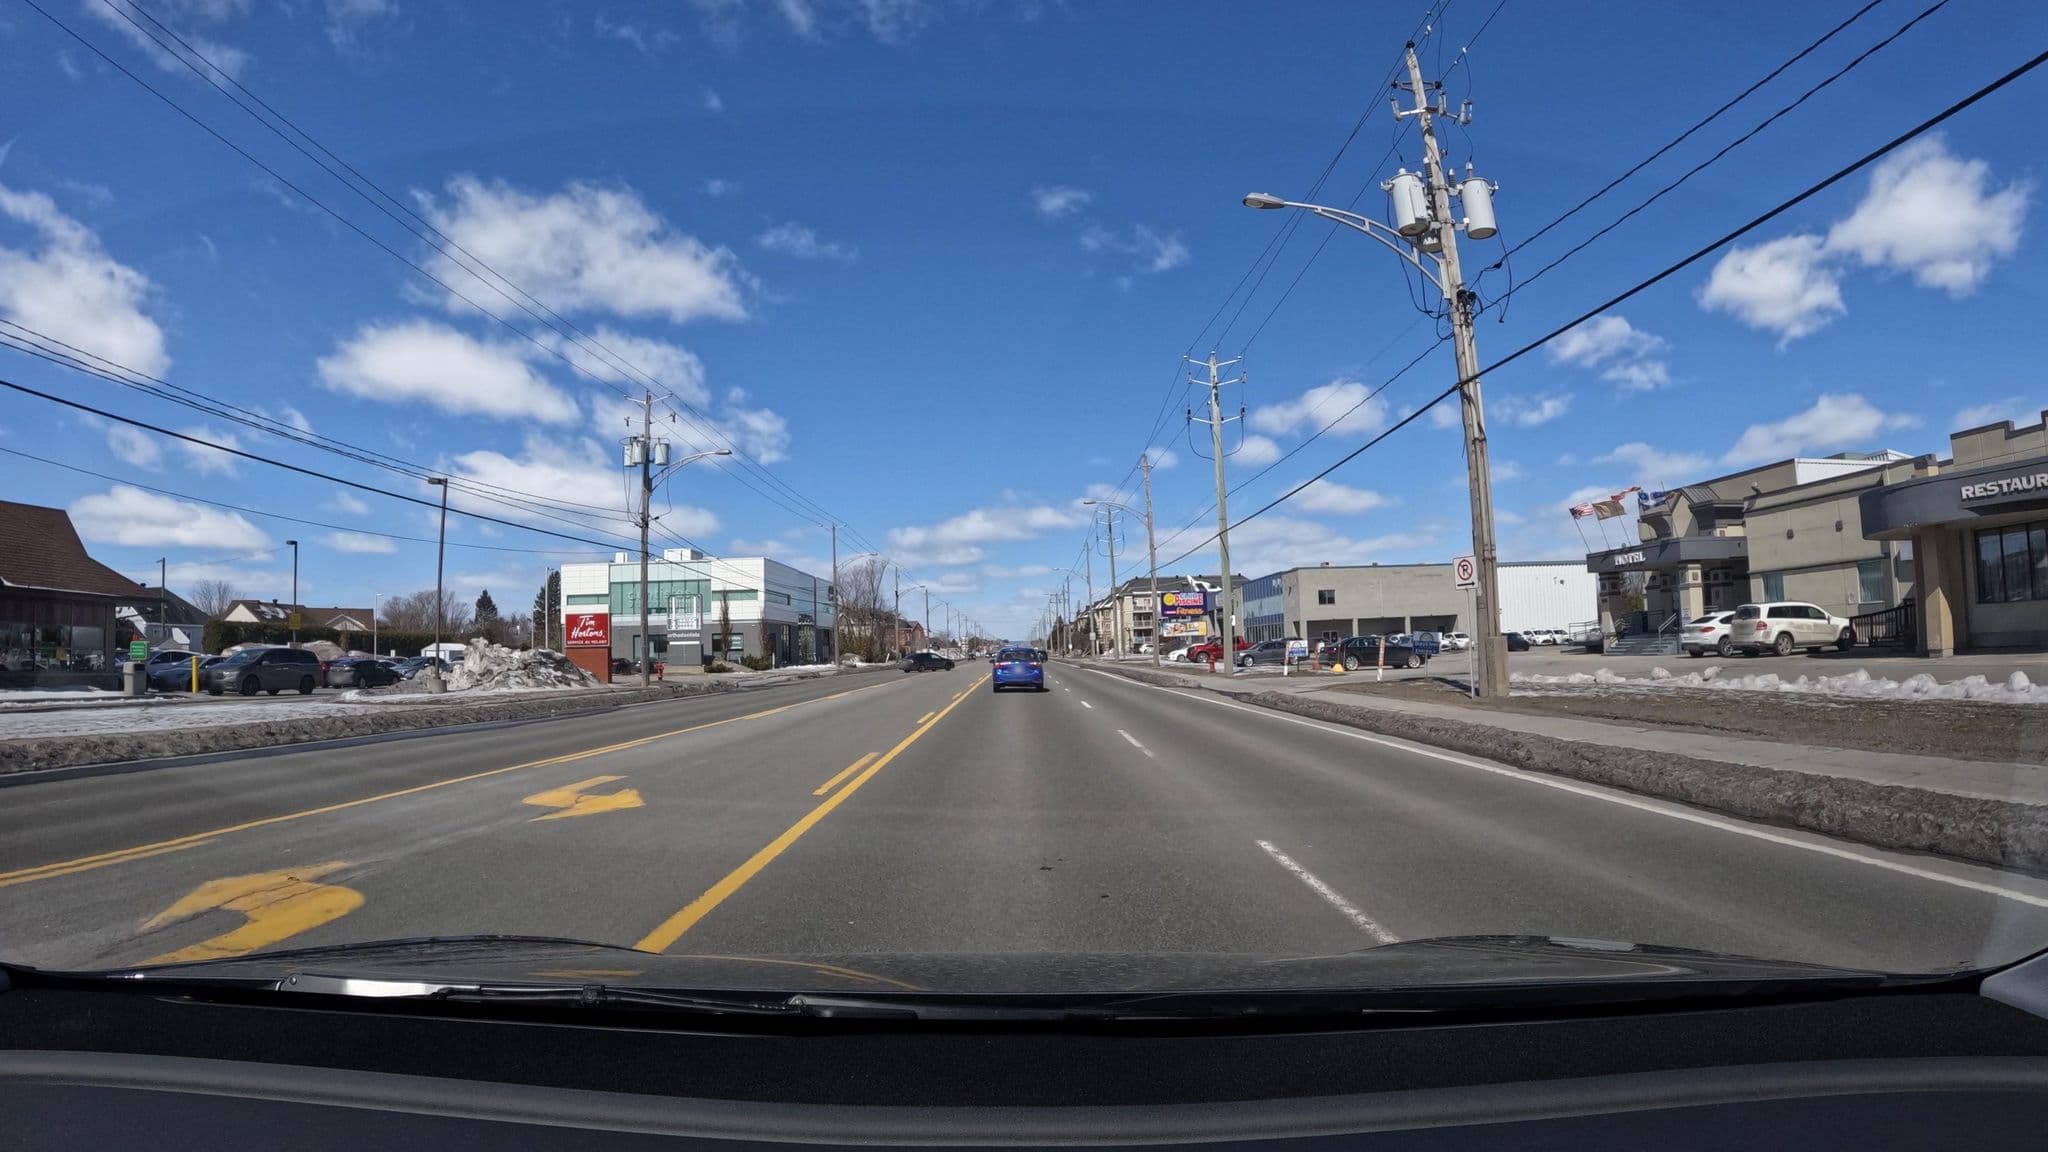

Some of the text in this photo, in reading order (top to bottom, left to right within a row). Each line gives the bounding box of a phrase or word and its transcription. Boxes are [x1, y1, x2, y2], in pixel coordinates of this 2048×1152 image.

[1961, 473, 2048, 499] RESTAUR
[1614, 551, 1646, 565] HOTEL
[579, 615, 595, 627] Tim
